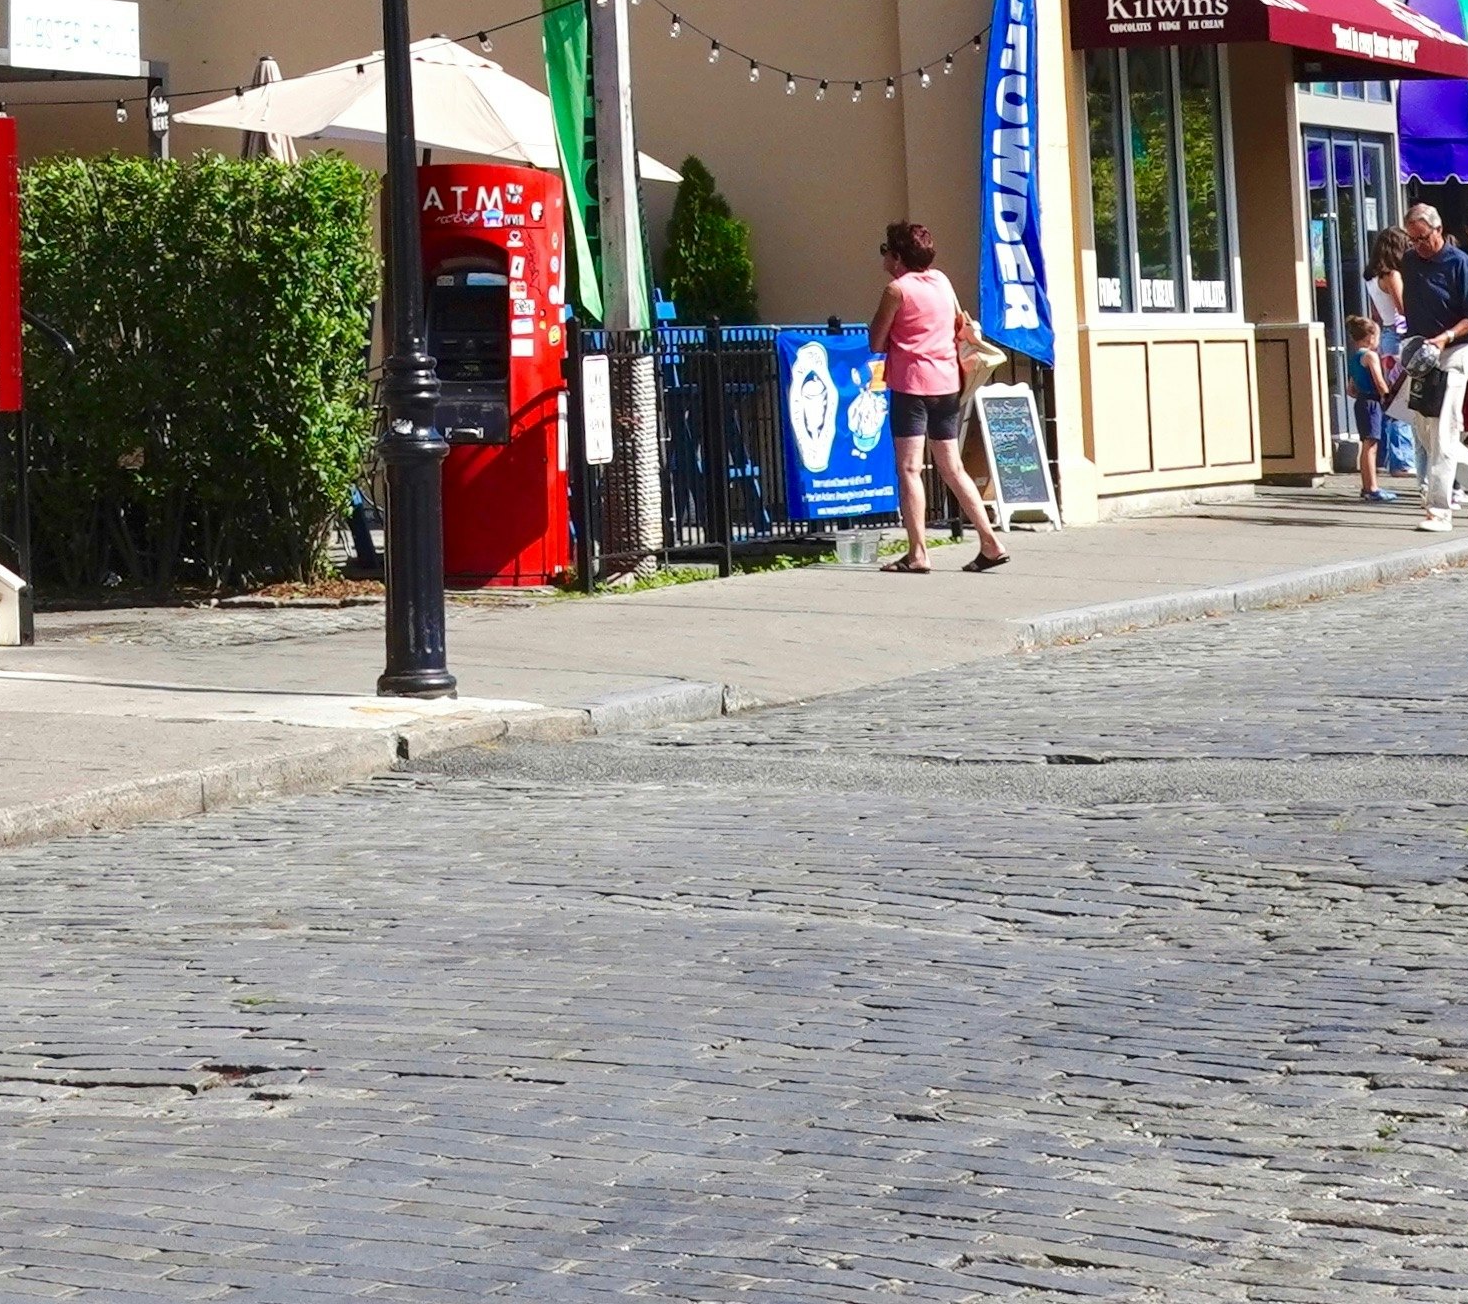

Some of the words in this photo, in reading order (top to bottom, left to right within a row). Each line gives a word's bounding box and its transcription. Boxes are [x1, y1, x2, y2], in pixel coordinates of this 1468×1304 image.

[1109, 22, 1152, 33] CHOCOLATES
[1158, 20, 1181, 31] FUDGE
[1188, 20, 1200, 30] ICE
[1200, 19, 1224, 30] CREAM
[422, 185, 504, 211] ATM
